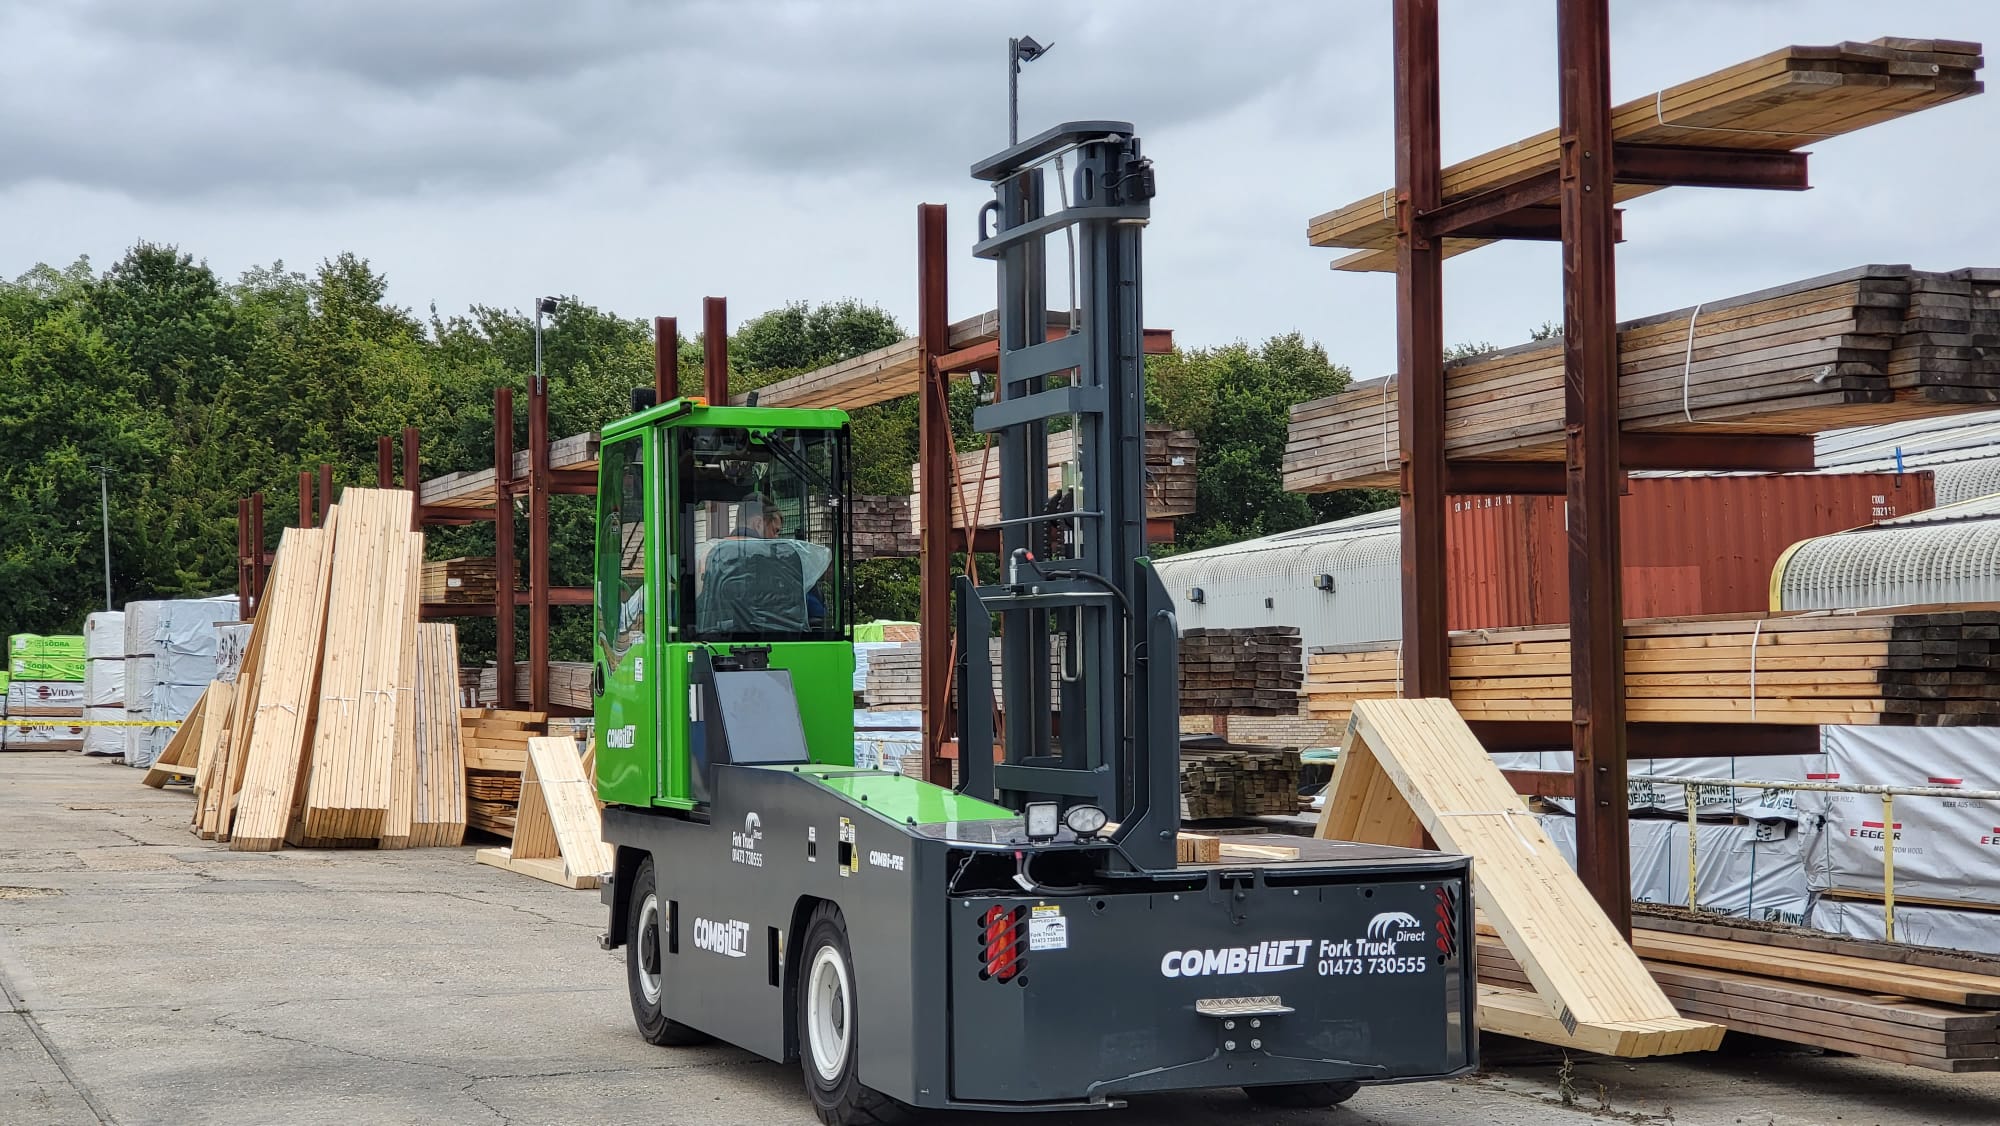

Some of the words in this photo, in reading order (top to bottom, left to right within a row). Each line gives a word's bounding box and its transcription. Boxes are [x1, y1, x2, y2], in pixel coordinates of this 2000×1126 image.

[1860, 829, 1901, 841] EGGR
[1396, 930, 1425, 942] Direct
[1319, 939, 1352, 958] Fork
[1355, 938, 1396, 957] Truck
[1318, 959, 1363, 976] 01473
[1368, 957, 1426, 975] 730555
